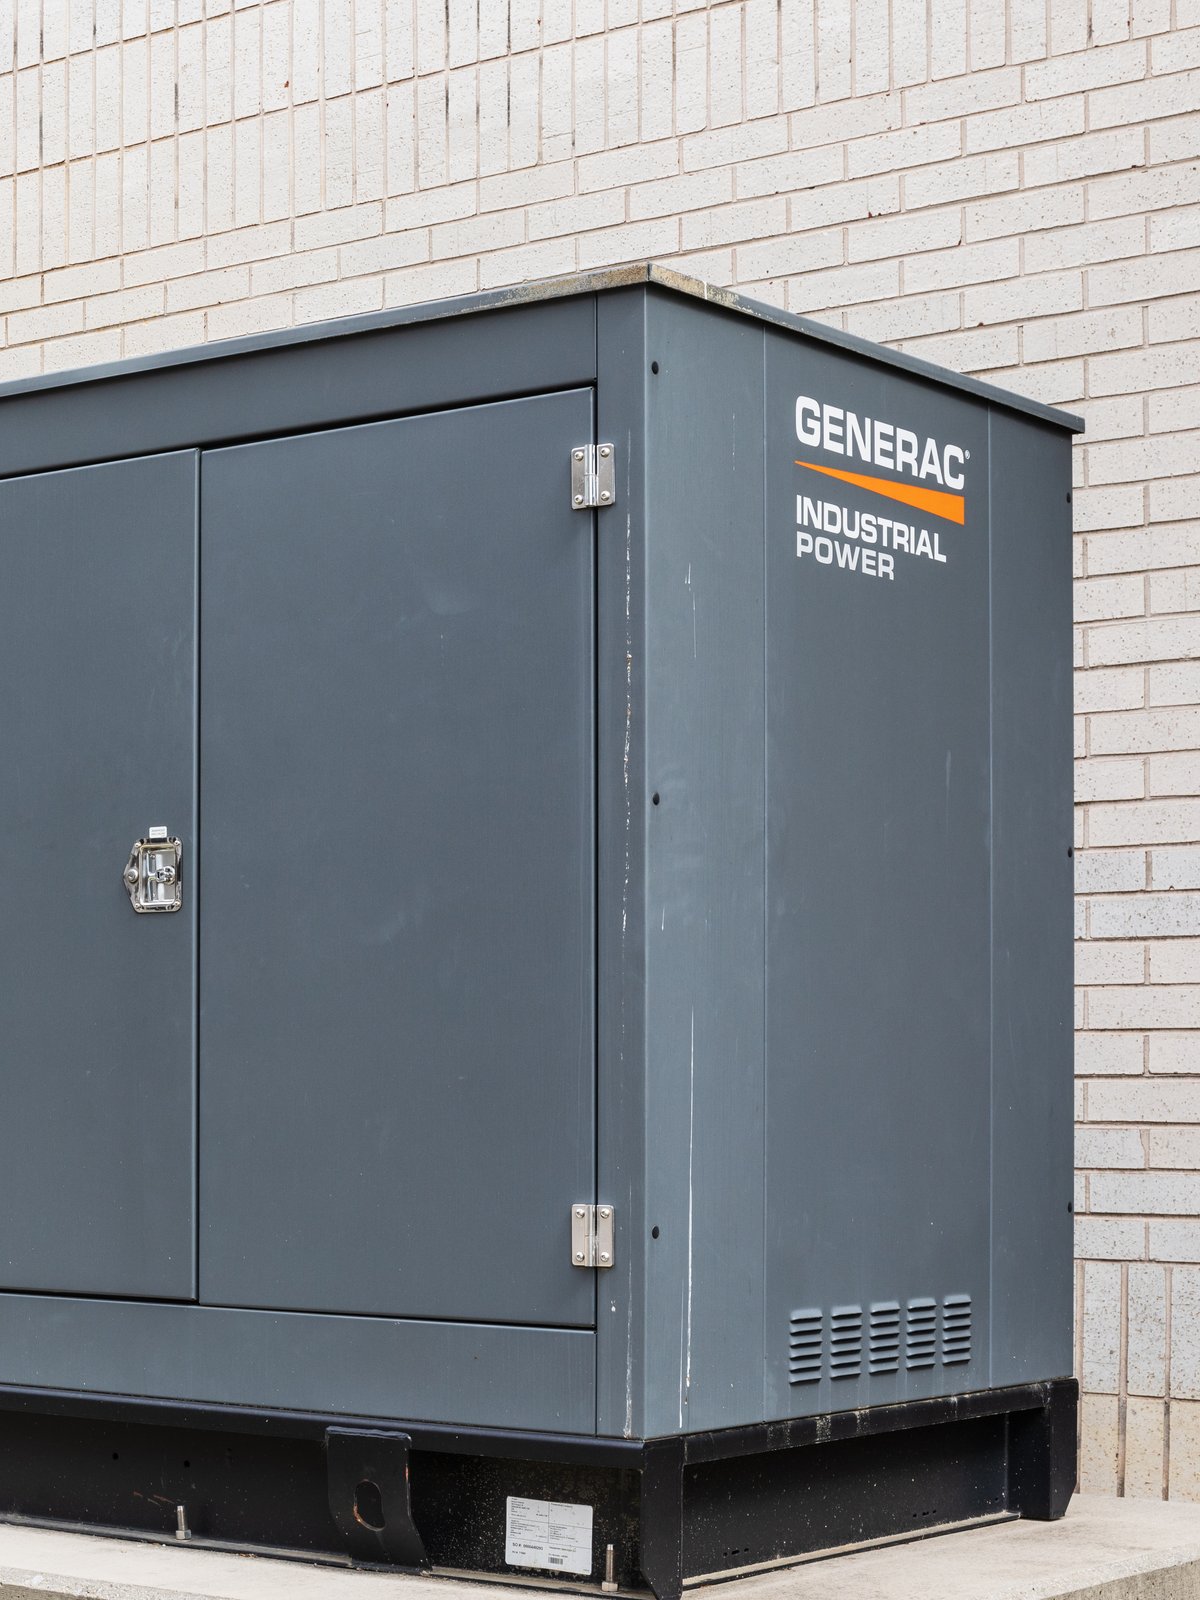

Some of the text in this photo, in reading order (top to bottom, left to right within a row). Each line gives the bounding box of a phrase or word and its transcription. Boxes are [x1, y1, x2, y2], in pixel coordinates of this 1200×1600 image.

[795, 395, 965, 490] GENERAC
[796, 494, 947, 563] INDUSTRIAL
[796, 530, 895, 581] POWER
